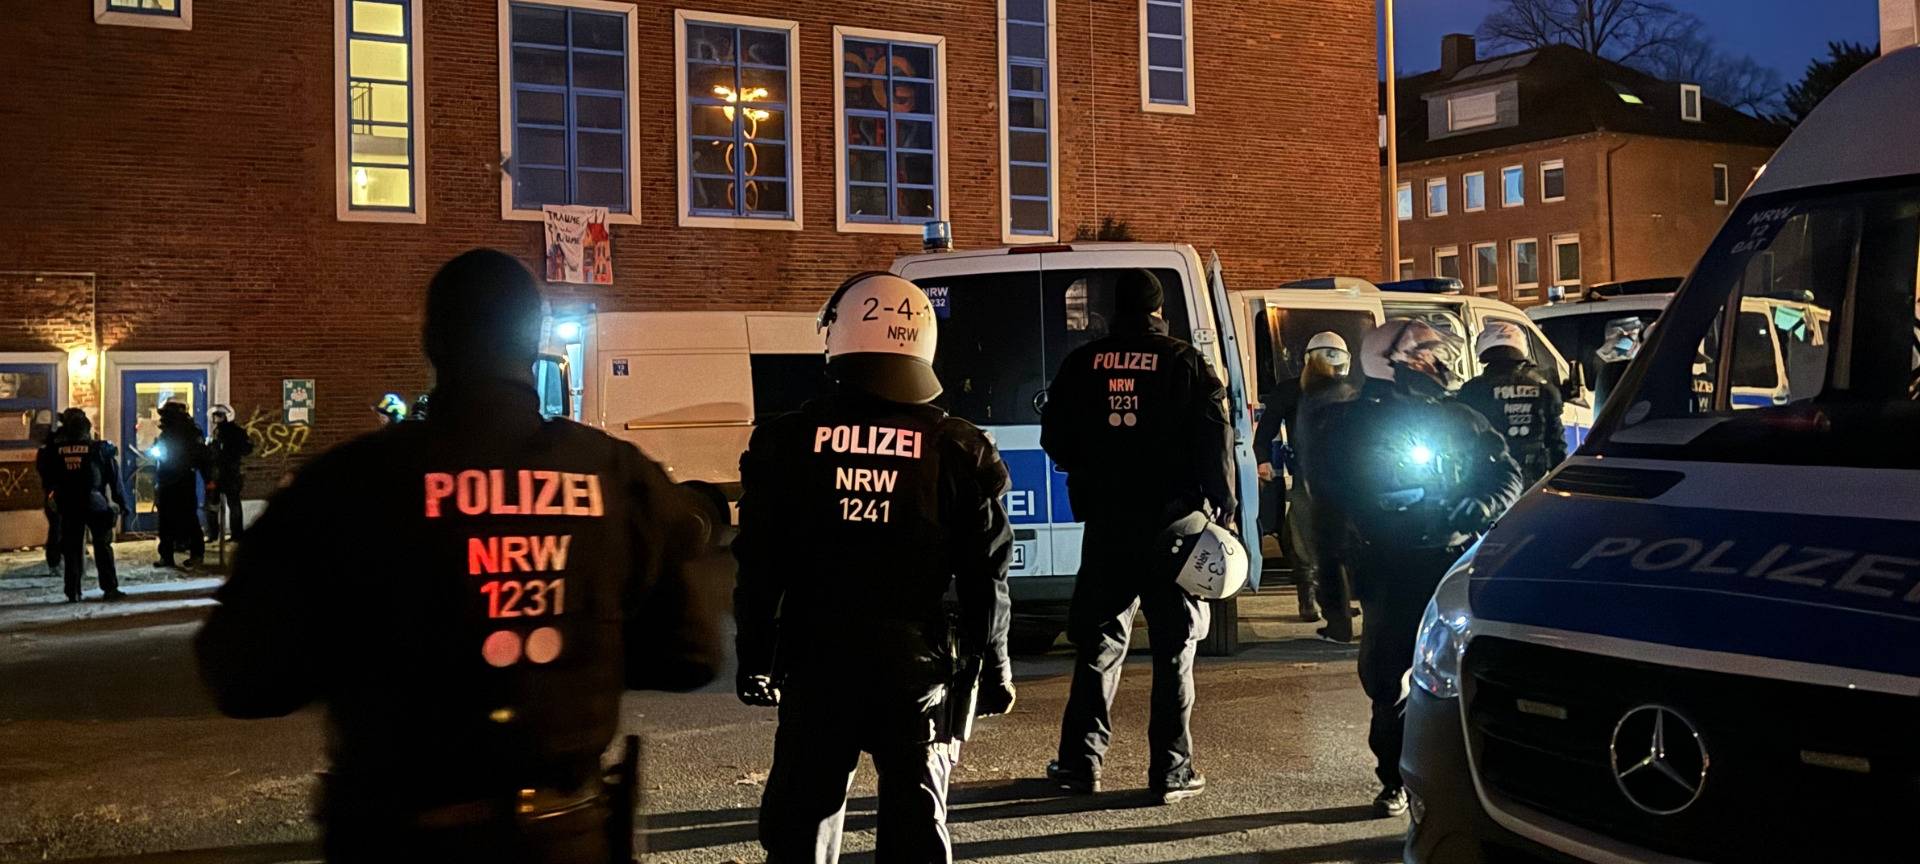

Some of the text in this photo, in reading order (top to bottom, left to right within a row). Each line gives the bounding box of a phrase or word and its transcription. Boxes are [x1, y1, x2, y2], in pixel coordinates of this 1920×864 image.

[1747, 206, 1796, 225] NRW
[931, 299, 945, 307] 232
[887, 325, 919, 342] NRW
[1092, 351, 1159, 371] POLIZEI
[1108, 378, 1135, 393] NRW
[1493, 385, 1540, 400] POLIZEI
[1107, 395, 1139, 410] 1231
[813, 425, 922, 460] POLIZEI
[835, 466, 899, 494] NRW
[423, 468, 606, 519] POLIZEI
[839, 497, 891, 523] 1241
[468, 534, 573, 576] NRW
[480, 577, 566, 619] 1231
